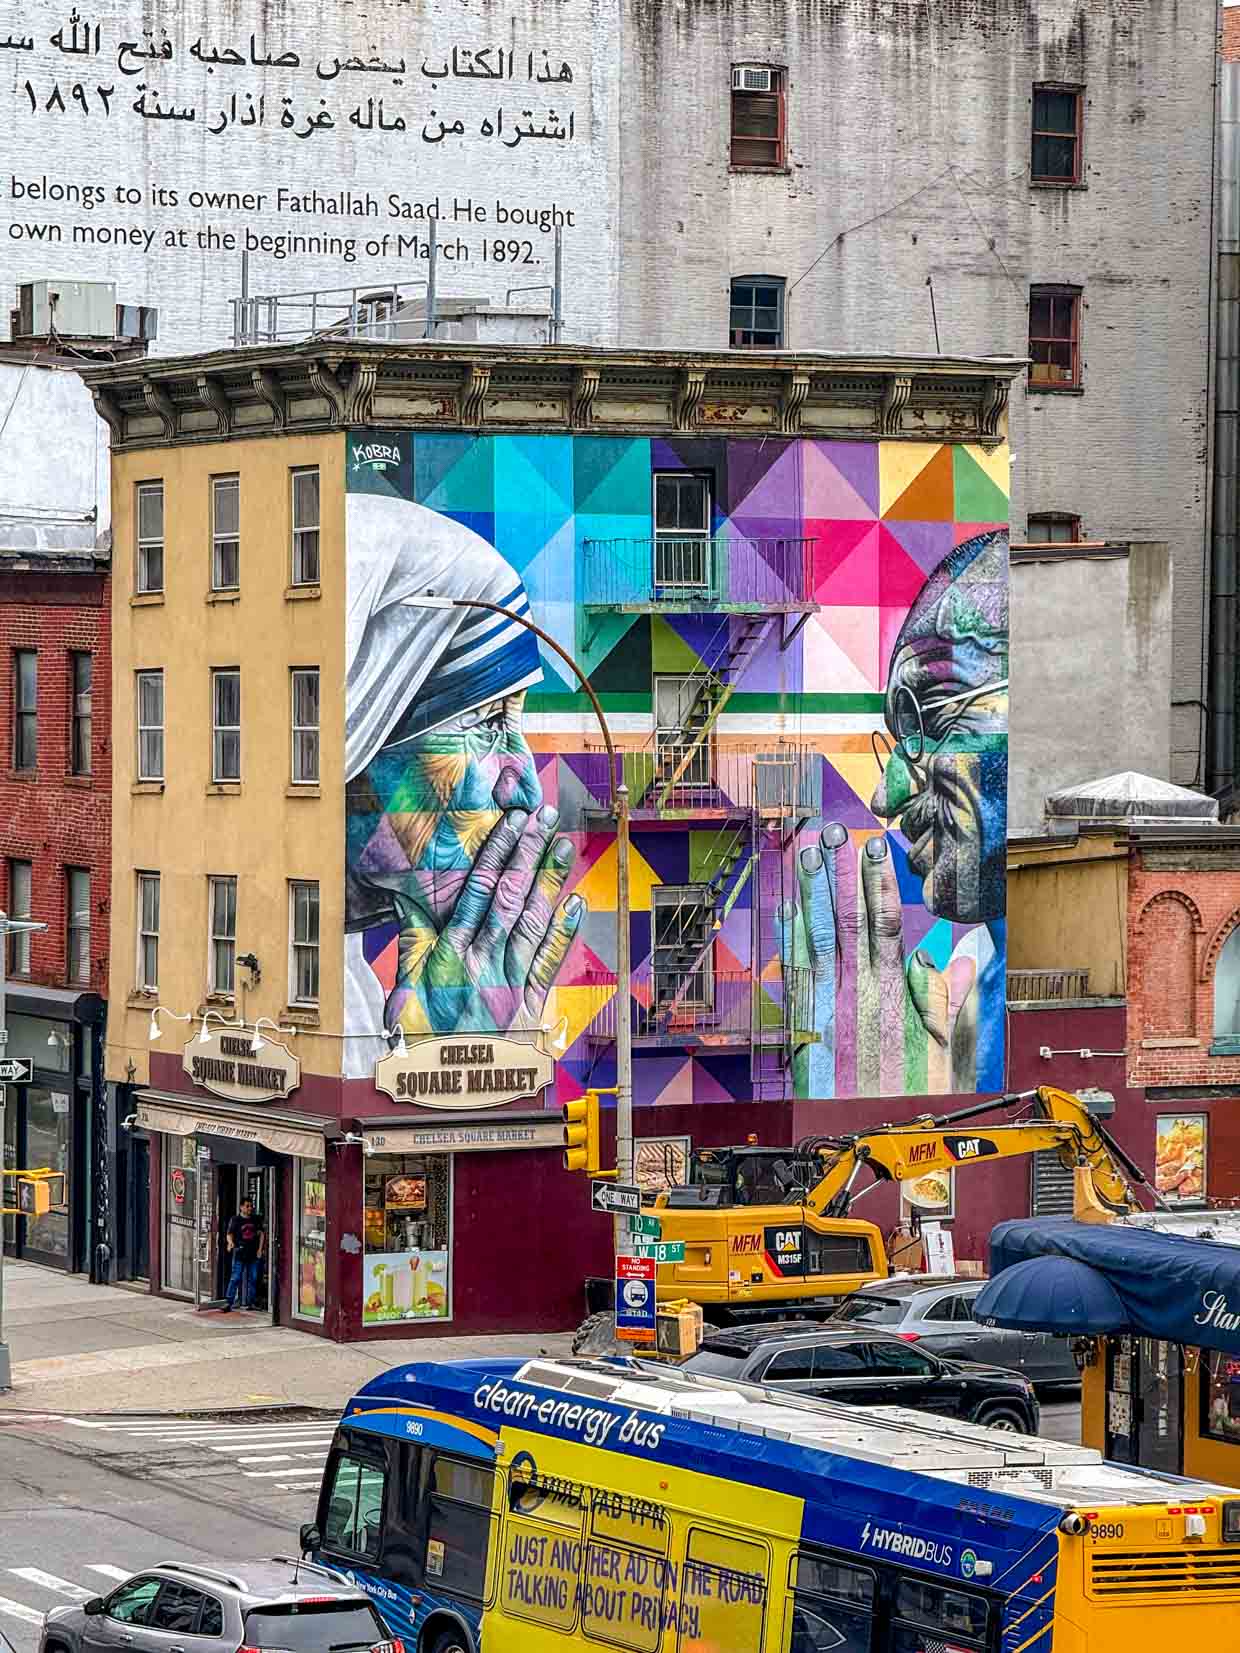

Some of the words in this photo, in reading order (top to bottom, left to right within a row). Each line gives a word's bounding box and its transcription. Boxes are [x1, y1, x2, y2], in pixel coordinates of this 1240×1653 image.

[117, 27, 174, 75] فتح
[189, 33, 300, 74] صاحبه
[421, 45, 513, 90] الكتاب
[528, 48, 574, 84] هذا
[24, 79, 115, 119] ١٨٩٢
[132, 83, 196, 122] سنة
[207, 92, 265, 135] اذار
[350, 97, 407, 132] ماله
[280, 97, 336, 138] غرة
[421, 109, 465, 143] من
[480, 107, 575, 148] اشتراه
[11, 175, 105, 210] belongs
[115, 184, 142, 205] to
[152, 183, 179, 207] its
[188, 191, 268, 211] owner
[276, 187, 379, 217] Fathallah
[387, 194, 447, 221] Saad.
[453, 198, 487, 223] He
[496, 200, 576, 233] bought
[8, 222, 62, 242] own
[72, 226, 156, 253] money
[164, 228, 188, 248] at
[196, 225, 236, 250] the
[245, 227, 357, 262] beginning
[365, 234, 391, 257] of
[397, 234, 469, 262] March
[483, 239, 541, 265] 1892.
[352, 444, 401, 461] KOBRA
[0, 1065, 20, 1075] WAY
[439, 1044, 495, 1066] CHELSEA
[192, 1055, 237, 1084] SQUARE
[237, 1062, 288, 1092] MARKET
[396, 1070, 463, 1099] SQUARE
[466, 1067, 539, 1094] MARKET
[413, 1129, 457, 1146] CHELSEA
[457, 1128, 496, 1145] SQUARE
[496, 1128, 537, 1143] MARKET
[908, 1141, 937, 1162] MFM
[957, 1138, 981, 1159] CAT
[601, 1190, 615, 1204] ONE
[620, 1193, 636, 1207] WAY
[638, 1245, 649, 1258] W
[654, 1244, 667, 1261] 18
[671, 1243, 681, 1253] ST
[731, 1233, 762, 1253] MFM
[775, 1231, 802, 1252] CAT
[622, 1263, 650, 1272] STANDING
[473, 1379, 622, 1447] clean-energy
[618, 1410, 667, 1449] bus
[871, 1526, 953, 1566] HYBRIDBUS
[1090, 1523, 1125, 1540] 9890
[509, 1533, 549, 1568] JUST
[549, 1538, 621, 1585] ANOTHER
[624, 1551, 649, 1585] AD
[653, 1559, 679, 1593] ON
[682, 1560, 712, 1597] THE
[366, 1582, 377, 1594] York
[377, 1586, 388, 1599] City
[387, 1589, 398, 1601] Bus
[573, 1582, 627, 1622] ABOUT
